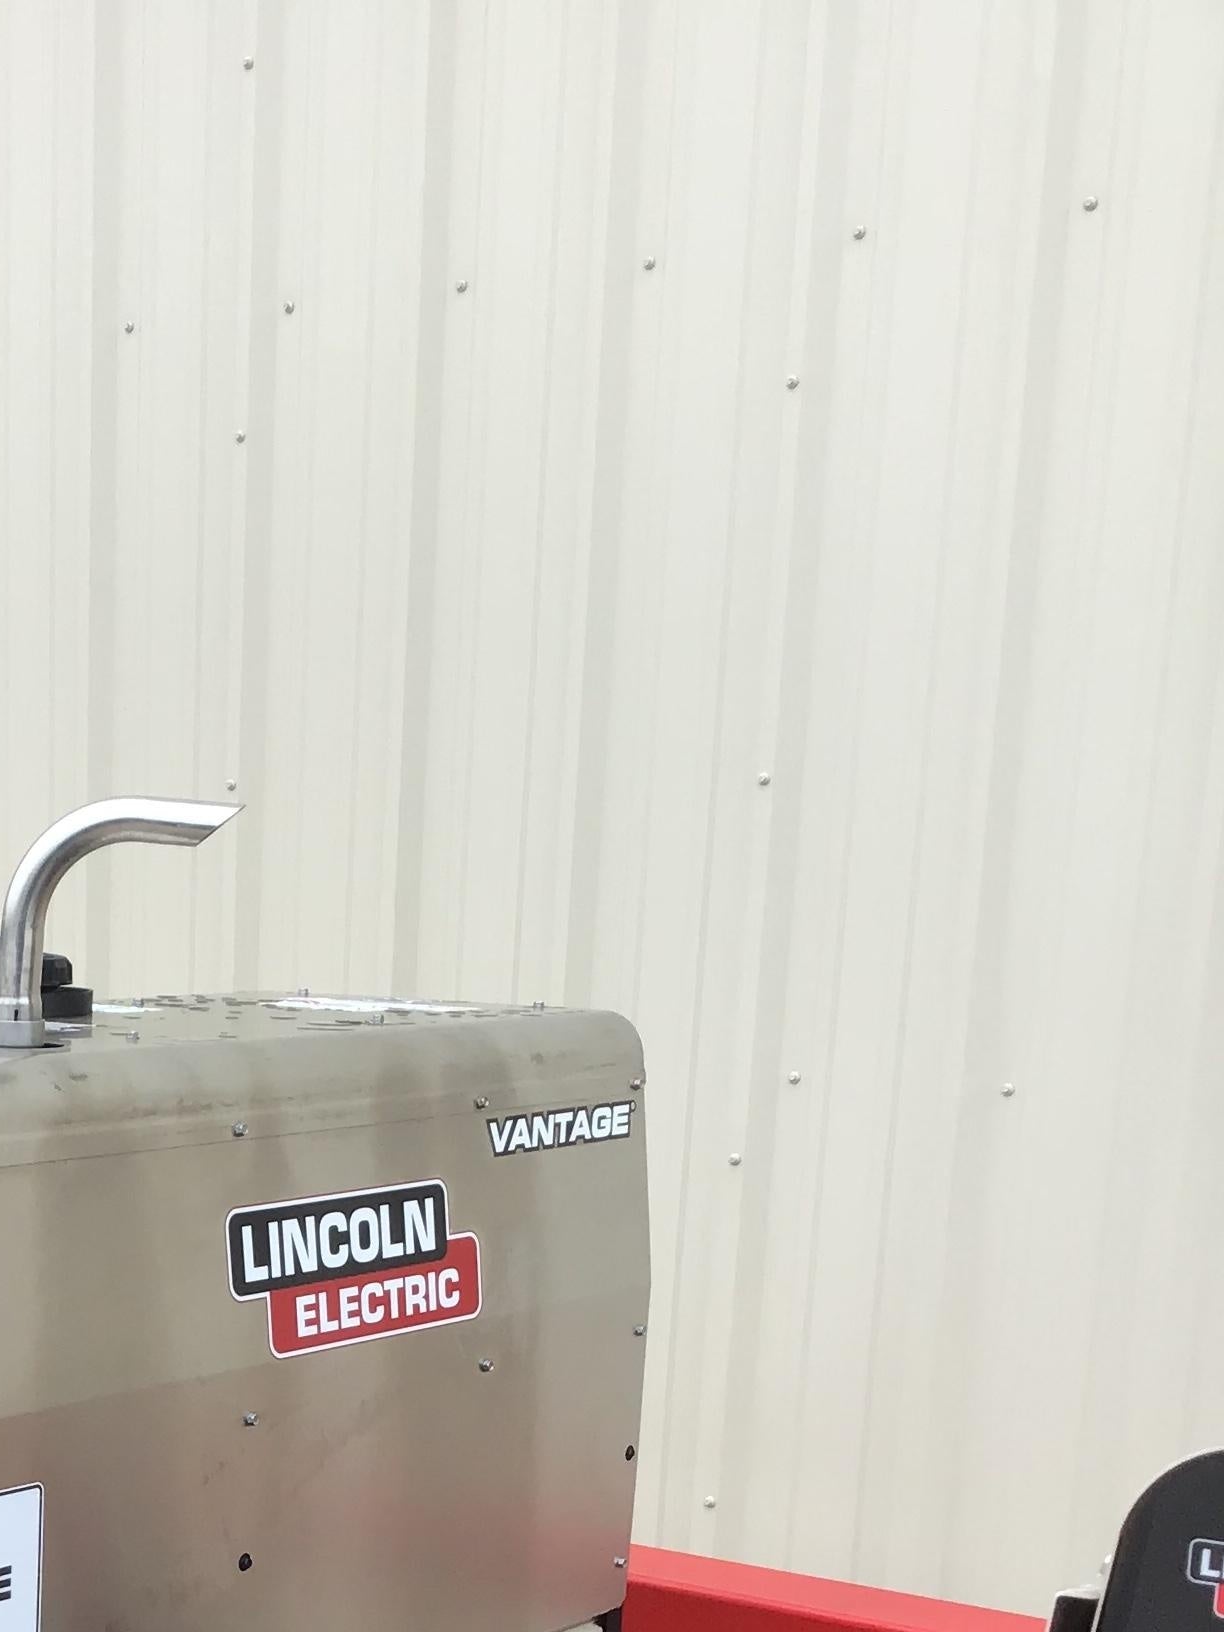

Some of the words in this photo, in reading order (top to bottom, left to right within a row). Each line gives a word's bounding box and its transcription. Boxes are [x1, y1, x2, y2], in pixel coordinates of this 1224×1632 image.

[489, 1103, 632, 1154] VANTAGE
[240, 1196, 437, 1285] LINCOLN
[295, 1267, 461, 1339] ELECTRIC
[1200, 1548, 1224, 1578] L
